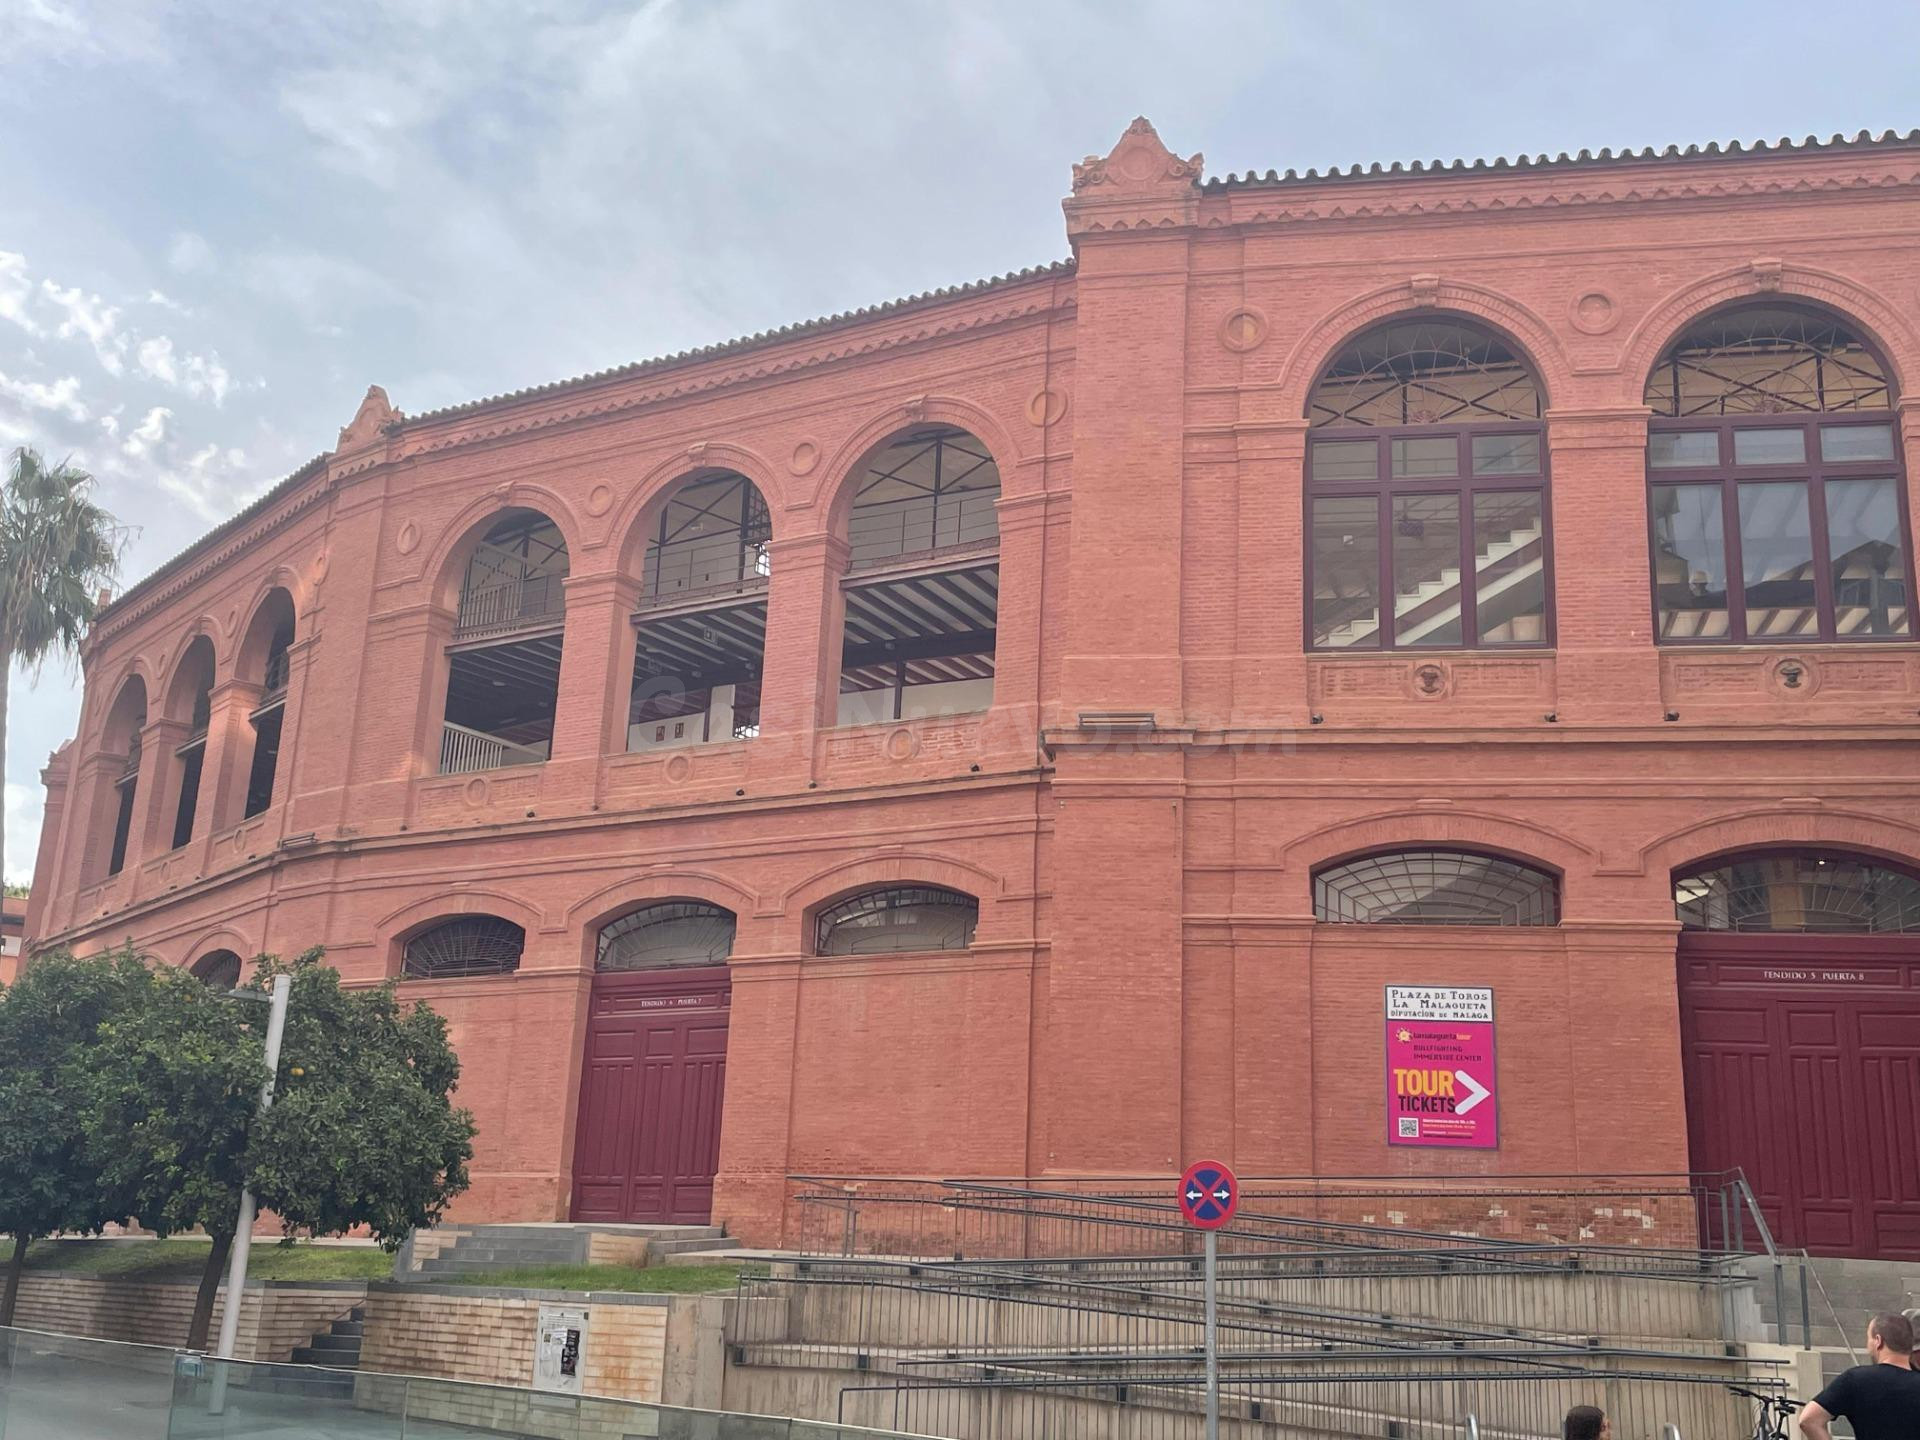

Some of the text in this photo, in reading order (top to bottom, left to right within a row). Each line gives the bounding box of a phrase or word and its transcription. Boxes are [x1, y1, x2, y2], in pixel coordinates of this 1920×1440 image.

[1764, 971, 1806, 980] TENDIDO
[1823, 972, 1856, 981] PUERTA
[1392, 990, 1431, 999] PLAZA
[1450, 991, 1488, 1000] TOROS
[1393, 999, 1486, 1009] LA MALAGUETA
[1393, 1069, 1455, 1097] TOUR
[1398, 1096, 1456, 1113] TICKETS
